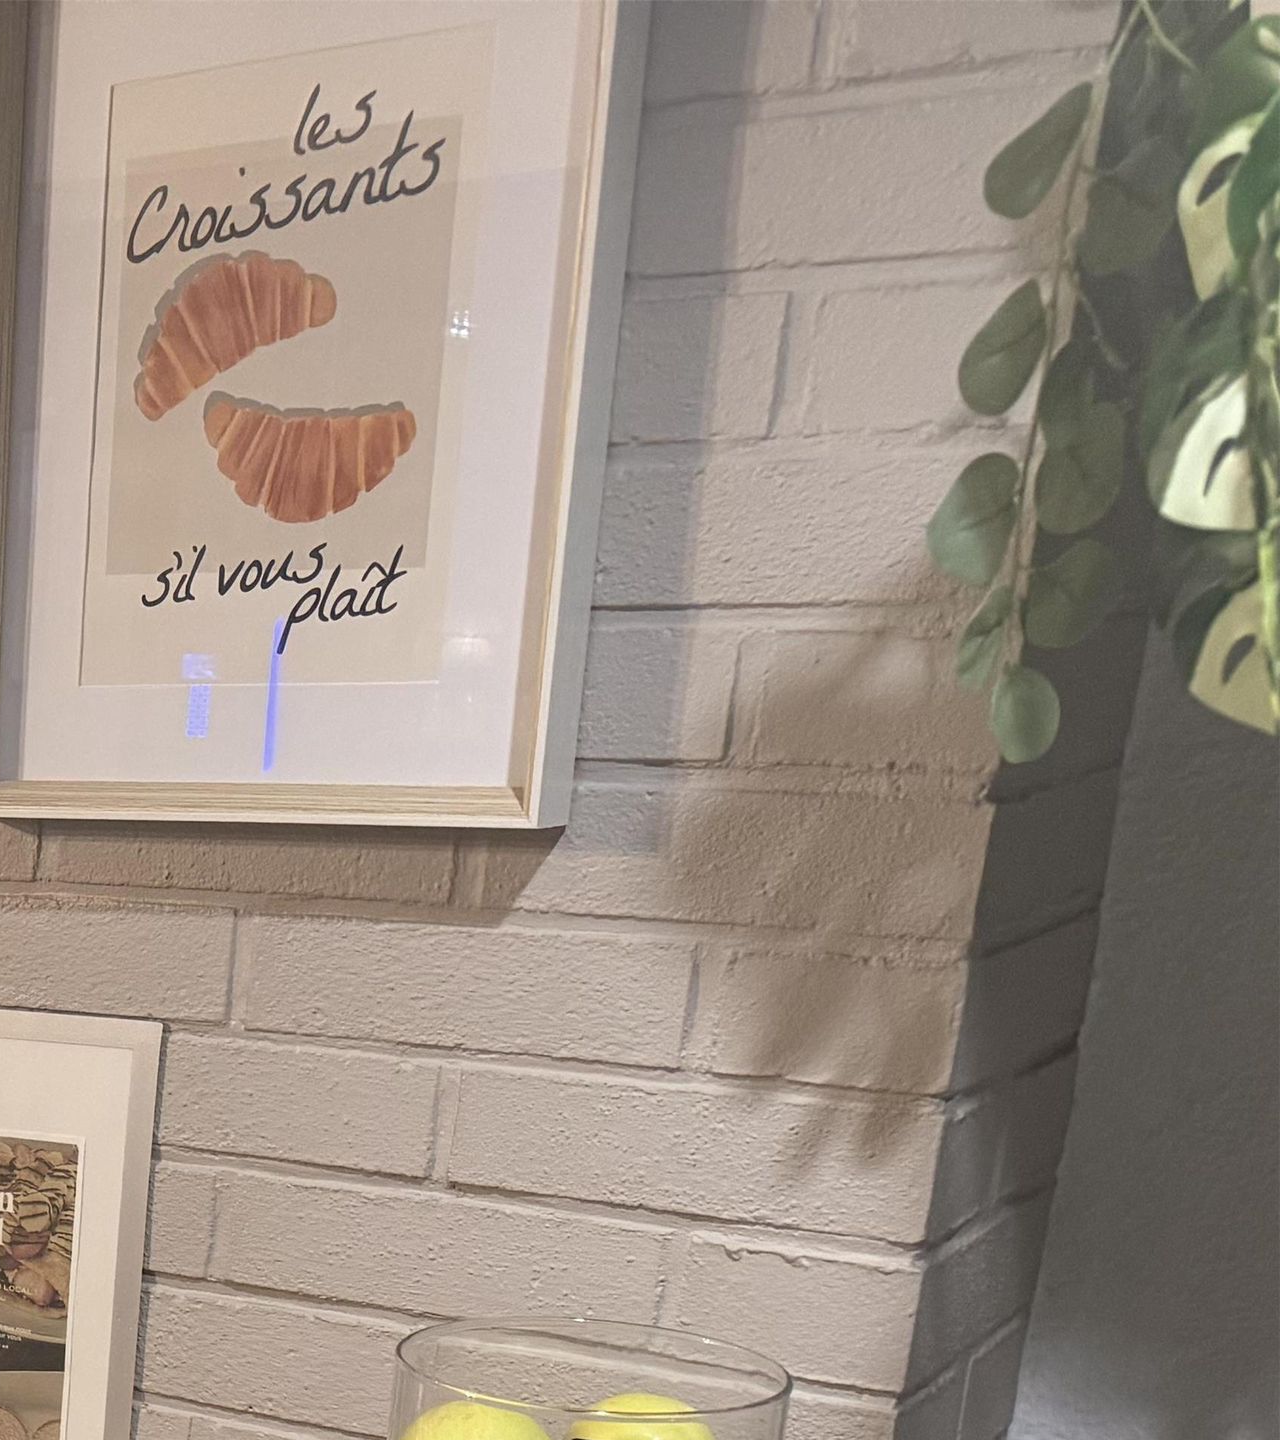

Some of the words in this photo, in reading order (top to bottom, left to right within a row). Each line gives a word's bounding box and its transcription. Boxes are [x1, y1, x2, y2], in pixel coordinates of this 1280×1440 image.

[293, 82, 378, 156] les
[126, 109, 447, 264] Croissants
[217, 541, 328, 597] vous
[276, 543, 409, 656] plaît
